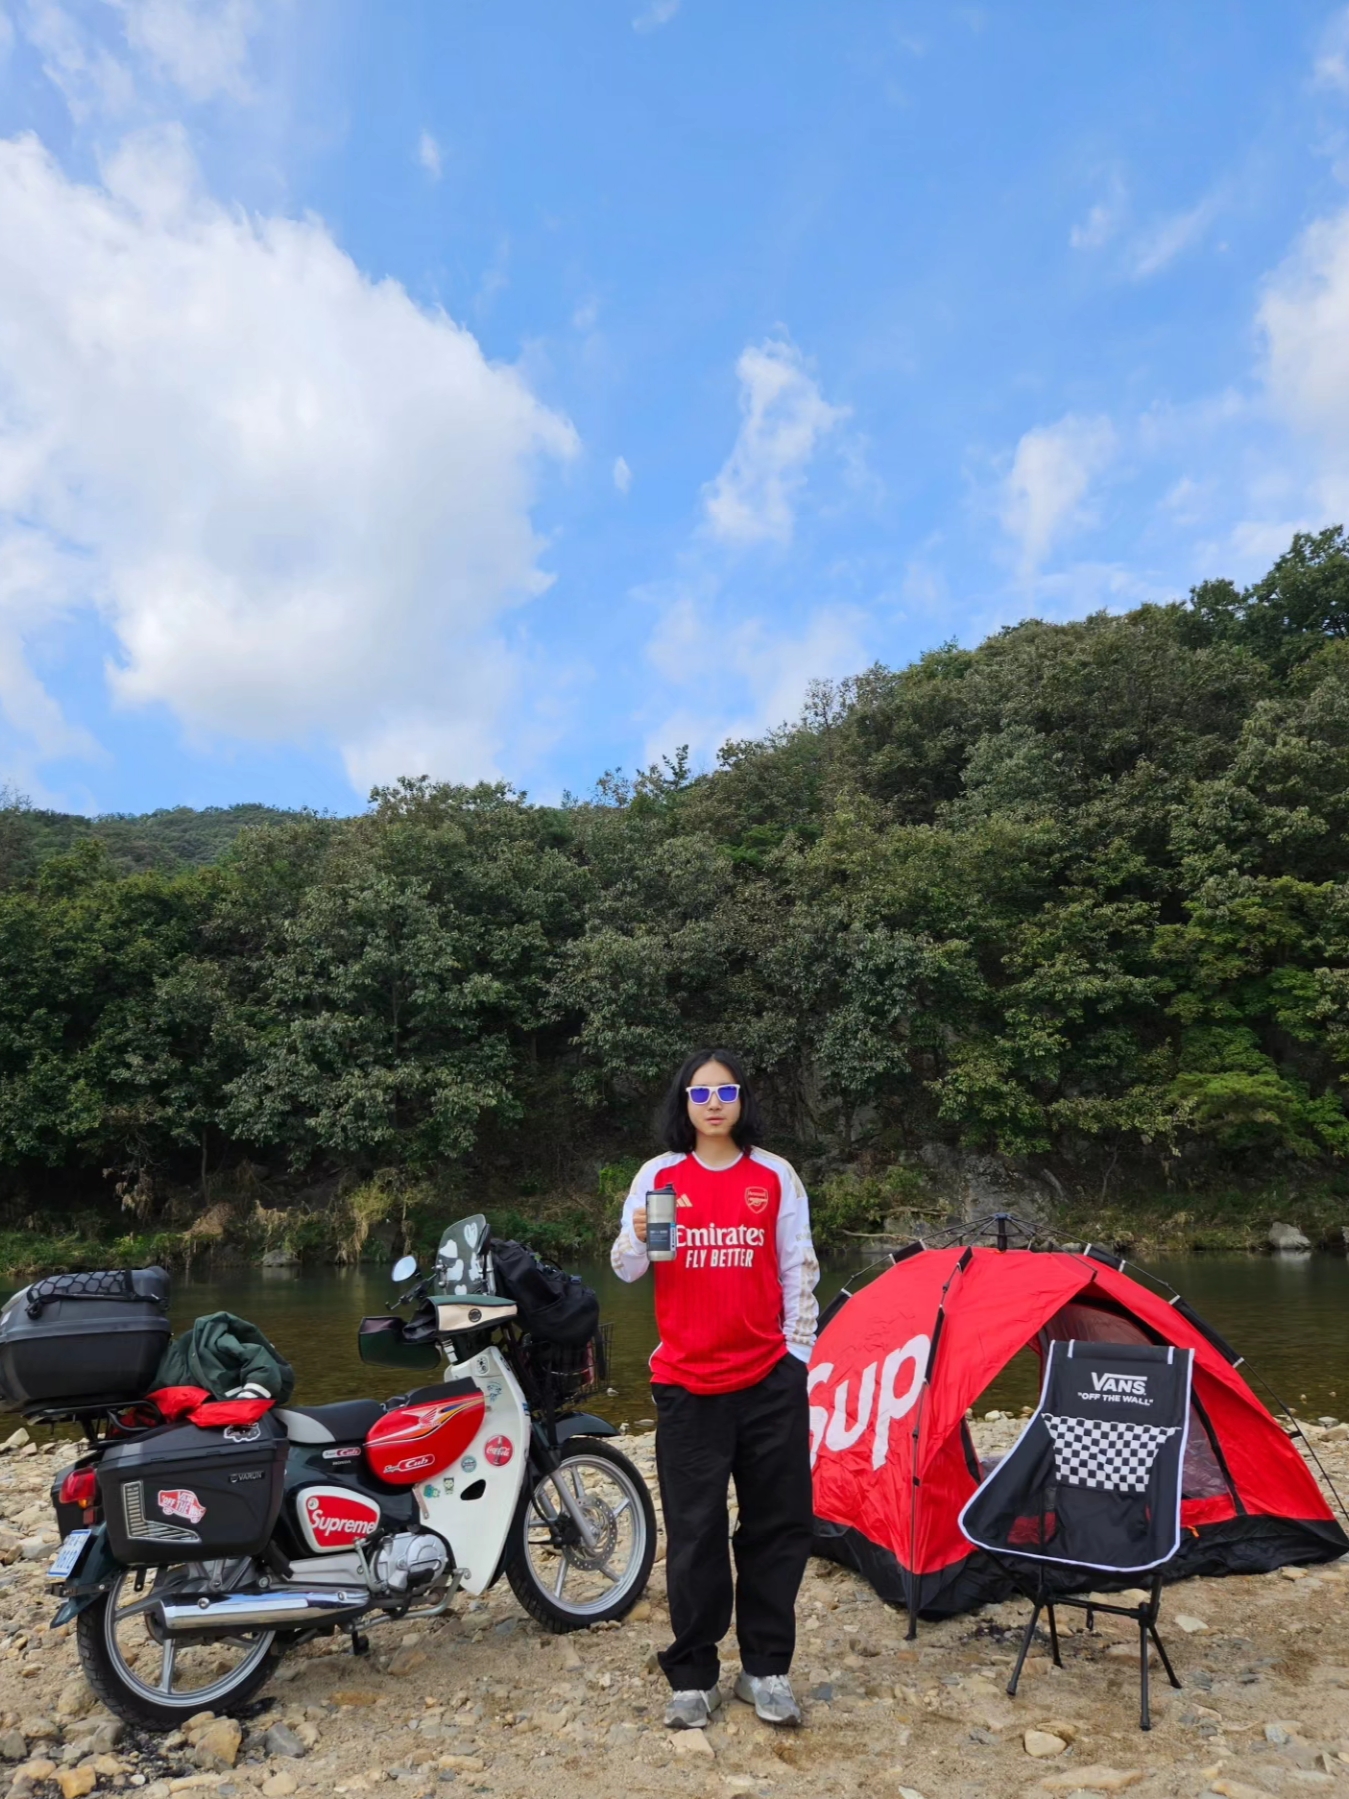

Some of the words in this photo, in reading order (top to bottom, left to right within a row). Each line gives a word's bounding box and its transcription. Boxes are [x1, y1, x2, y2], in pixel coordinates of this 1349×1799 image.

[675, 1222, 765, 1248] Emirates
[685, 1249, 707, 1269] FLY
[710, 1247, 754, 1268] BETTER
[1091, 1371, 1148, 1396] VANS
[807, 1334, 931, 1471] Sup
[1077, 1391, 1101, 1401] "OFF
[1103, 1393, 1121, 1403] THE
[1122, 1395, 1154, 1406] WALL"
[405, 1456, 429, 1469] Cub
[311, 1509, 377, 1537] Supreme
